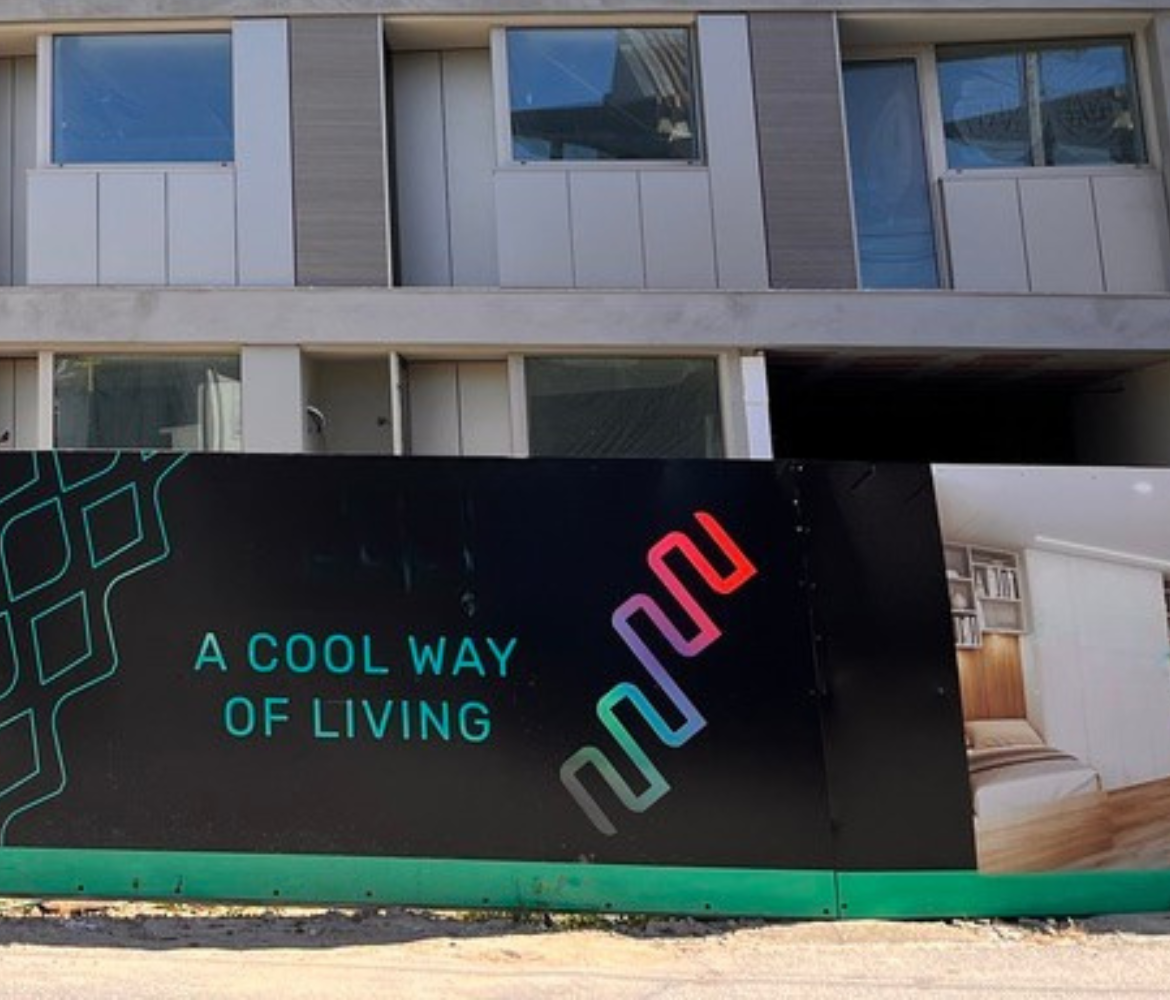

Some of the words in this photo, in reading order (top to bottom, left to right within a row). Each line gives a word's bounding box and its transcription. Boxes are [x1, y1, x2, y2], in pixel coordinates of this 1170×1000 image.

[195, 632, 228, 671] A
[248, 632, 389, 674] COOL
[408, 635, 517, 677] WAY
[224, 696, 289, 737] OF
[313, 698, 491, 742] LIVING
